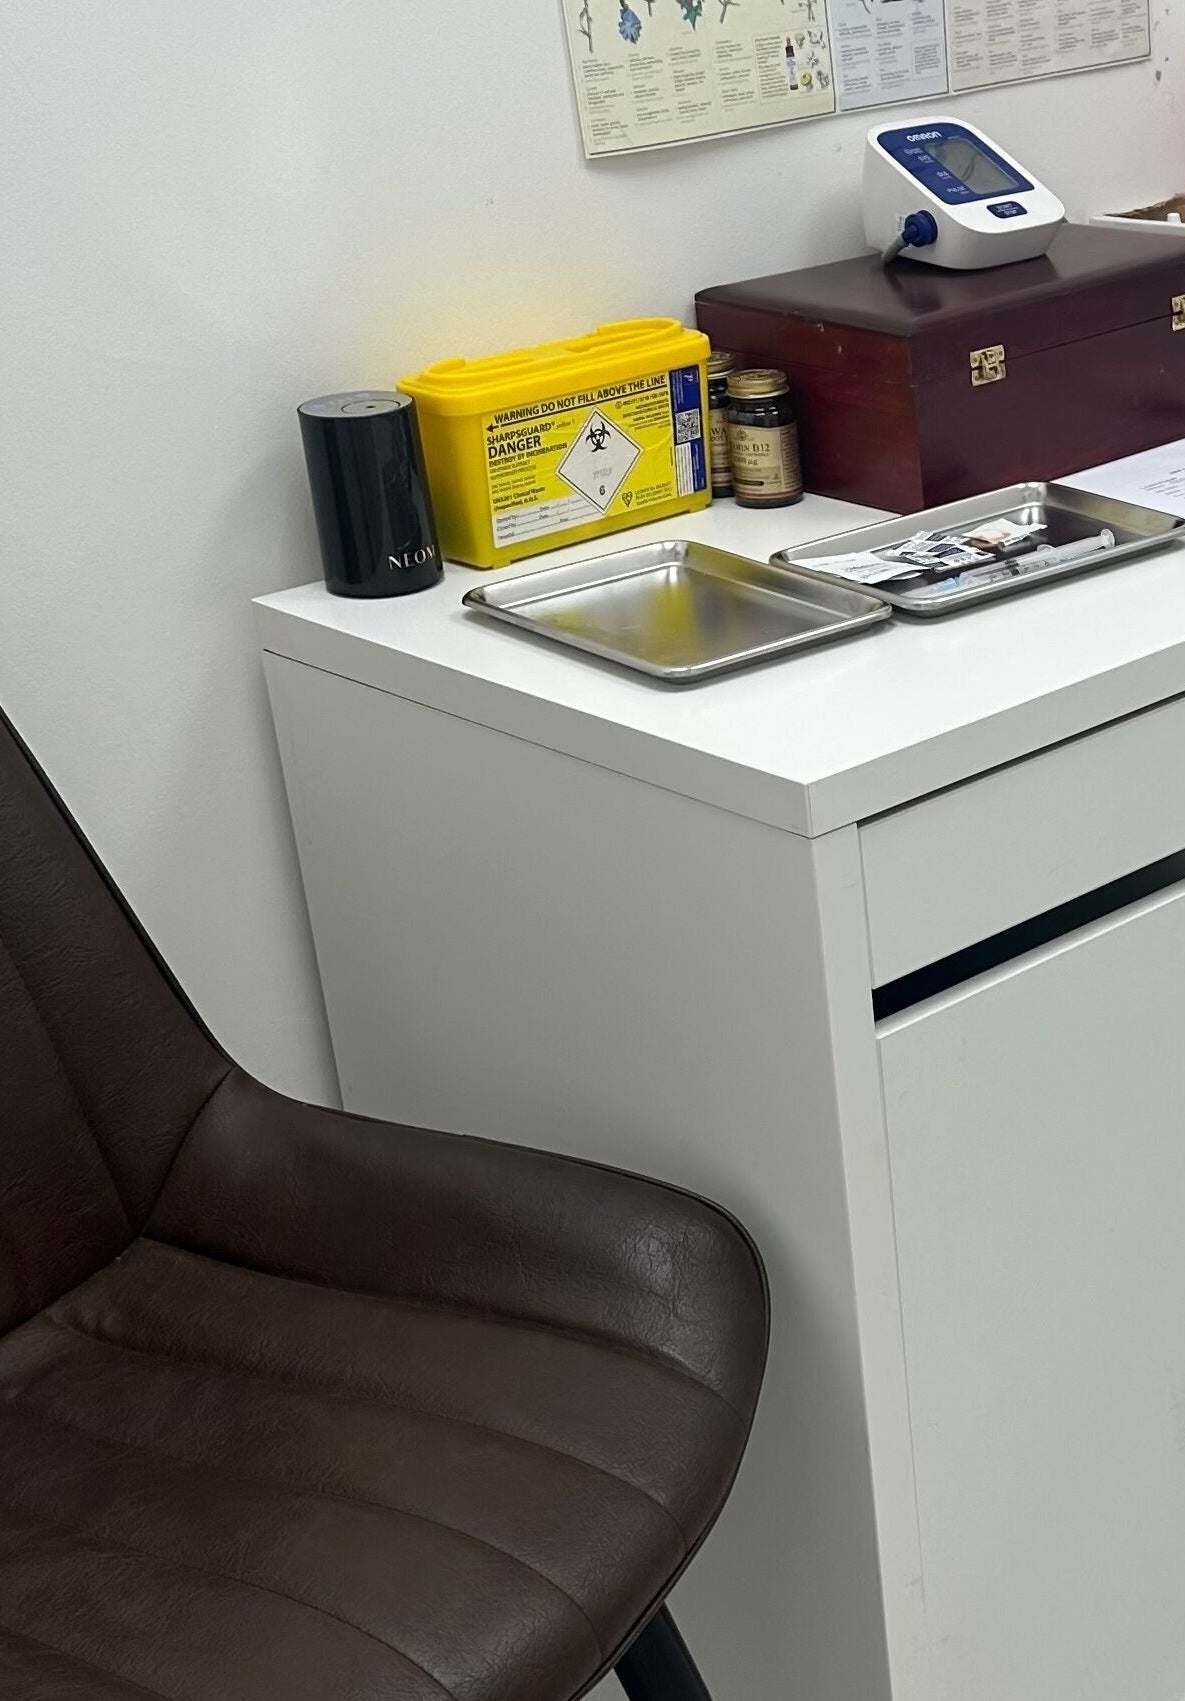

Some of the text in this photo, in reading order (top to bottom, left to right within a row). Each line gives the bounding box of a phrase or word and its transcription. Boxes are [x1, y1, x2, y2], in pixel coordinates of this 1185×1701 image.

[494, 375, 666, 424] WARNING DO NOT FILL ABOVE THE LINE
[488, 435, 542, 459] DANGER
[752, 443, 770, 452] B12
